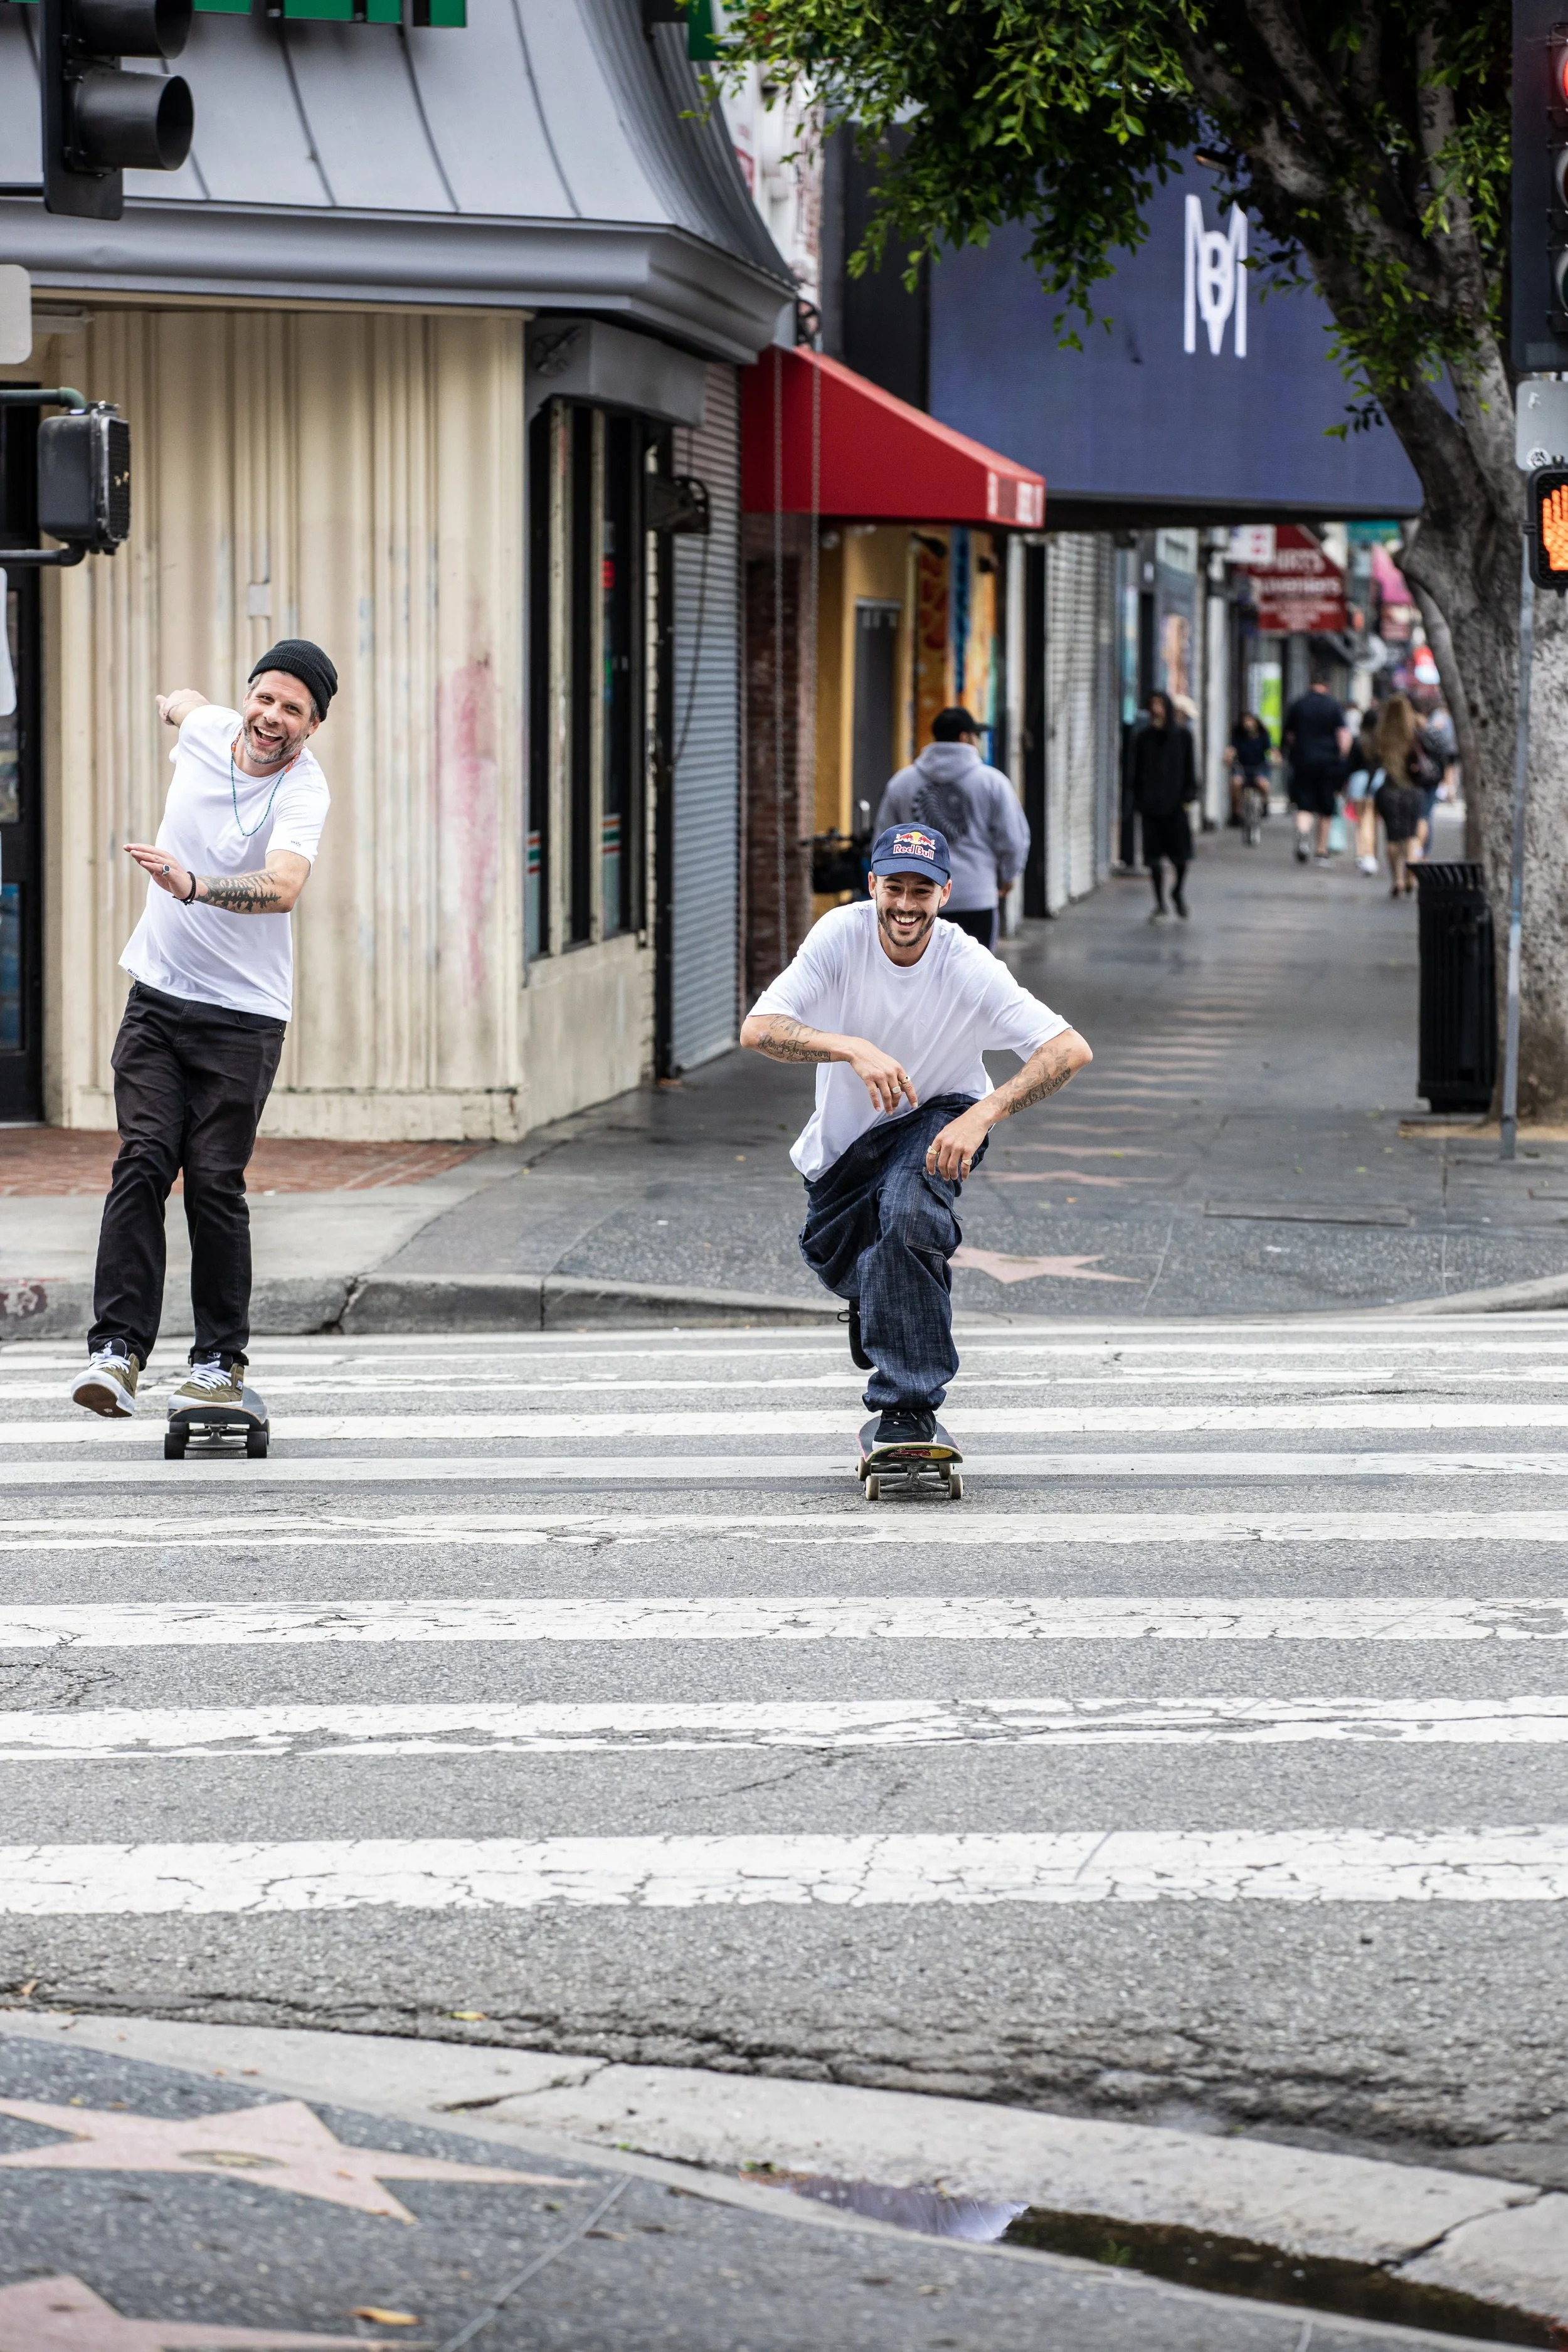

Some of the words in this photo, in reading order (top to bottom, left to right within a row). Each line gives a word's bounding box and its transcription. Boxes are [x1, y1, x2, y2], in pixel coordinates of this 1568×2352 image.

[893, 844, 915, 854] Red
[914, 845, 935, 860] Bull
[787, 1039, 831, 1061] Temporary
[1008, 1098, 1028, 1115] Love
